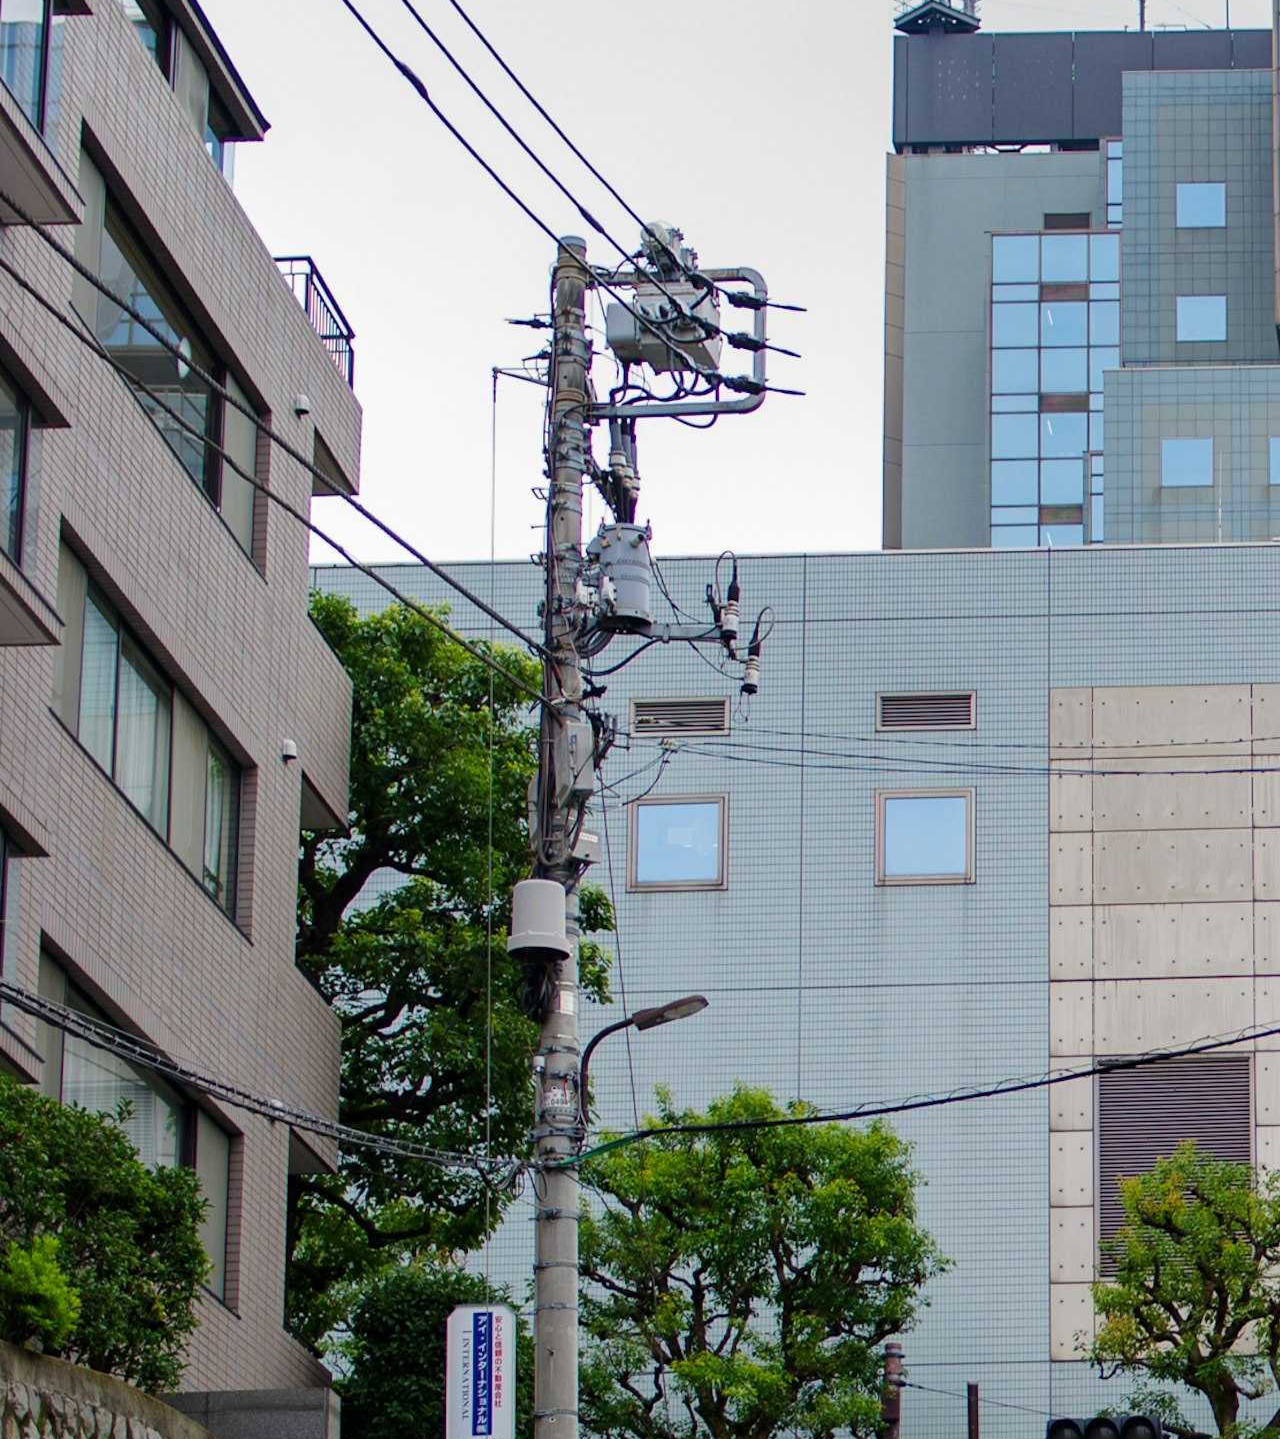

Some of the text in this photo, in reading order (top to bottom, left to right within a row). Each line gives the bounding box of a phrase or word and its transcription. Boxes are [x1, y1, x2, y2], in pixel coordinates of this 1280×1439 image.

[461, 1338, 470, 1422] INTERNATIONAL
[494, 1315, 503, 1408] 安心と信頼の不動産会社
